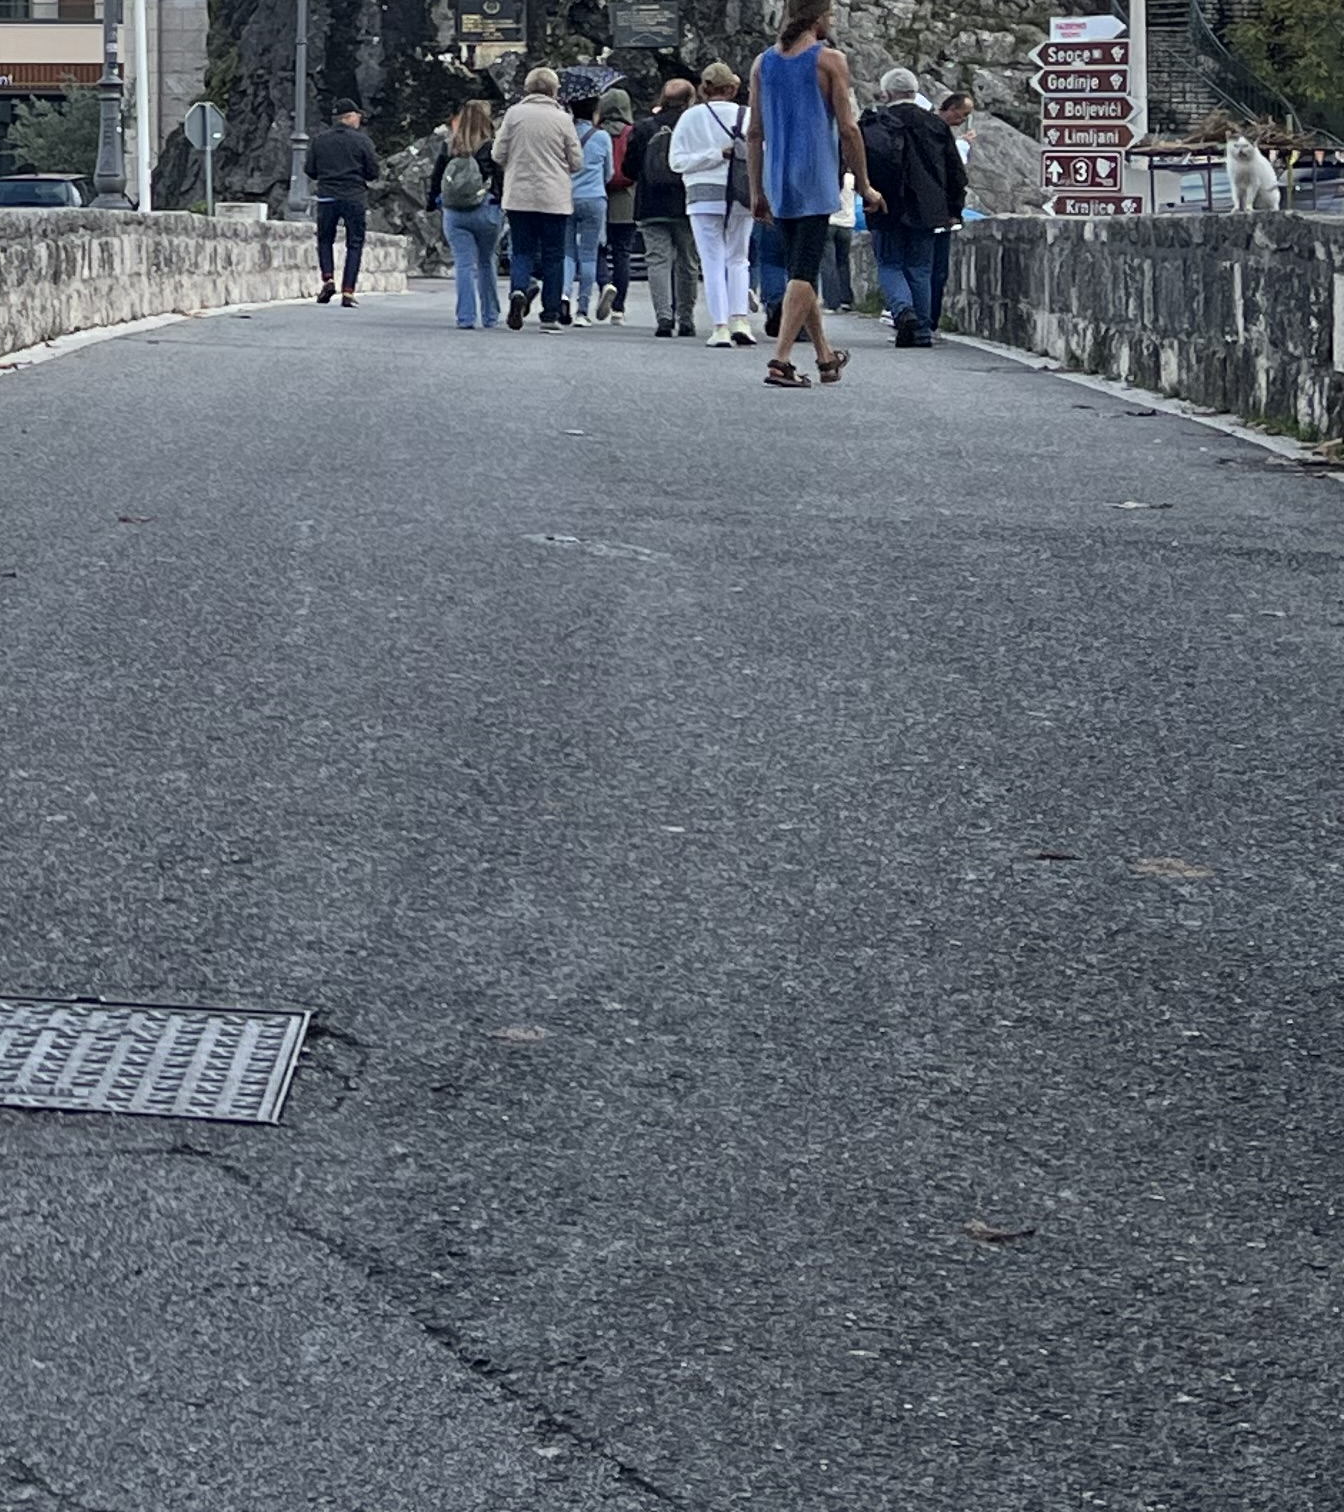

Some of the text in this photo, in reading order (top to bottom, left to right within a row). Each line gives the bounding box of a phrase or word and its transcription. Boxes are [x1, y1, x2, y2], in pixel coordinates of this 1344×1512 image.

[1047, 46, 1091, 63] Seoce
[1047, 74, 1099, 93] Godinje
[1064, 128, 1119, 147] Limljani
[1075, 161, 1087, 181] 3
